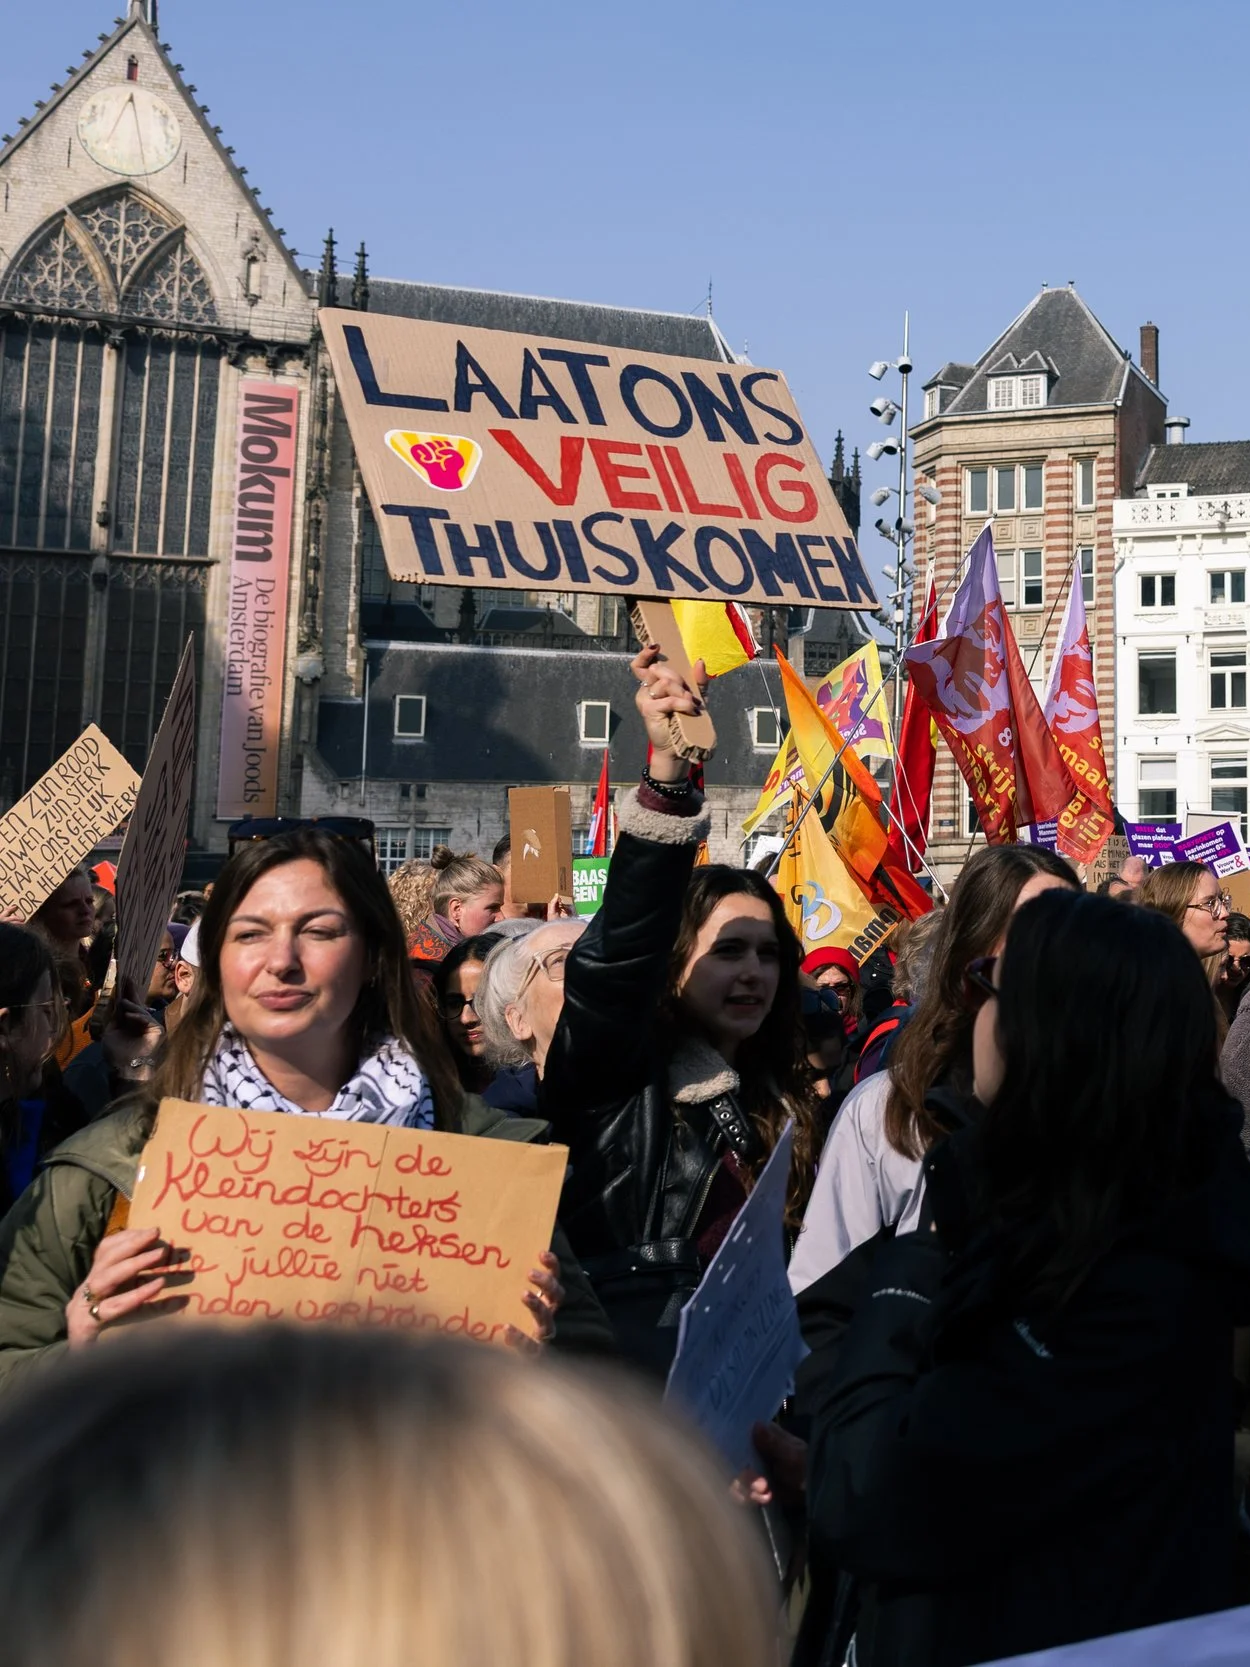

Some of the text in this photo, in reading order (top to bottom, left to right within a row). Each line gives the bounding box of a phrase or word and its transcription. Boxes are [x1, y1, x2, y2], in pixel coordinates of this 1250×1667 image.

[235, 393, 293, 563] Mokum
[487, 428, 818, 524] VEILIG
[381, 503, 879, 604] THUISKOMEN
[226, 575, 253, 697] Amsterdam
[243, 577, 276, 803] De biografie van Joods
[55, 737, 100, 784] ROOD
[66, 753, 110, 806] STERK
[101, 781, 139, 826] WERK
[40, 829, 70, 862] ONS
[1184, 837, 1223, 857] jaarinkomen
[1217, 860, 1234, 869] Vrouw
[1220, 866, 1234, 874] Werk
[188, 1113, 276, 1175] Wij
[395, 1144, 453, 1177] de
[181, 1208, 511, 1269] van de heksen
[225, 1246, 342, 1288] jullie
[358, 1263, 428, 1293] niet
